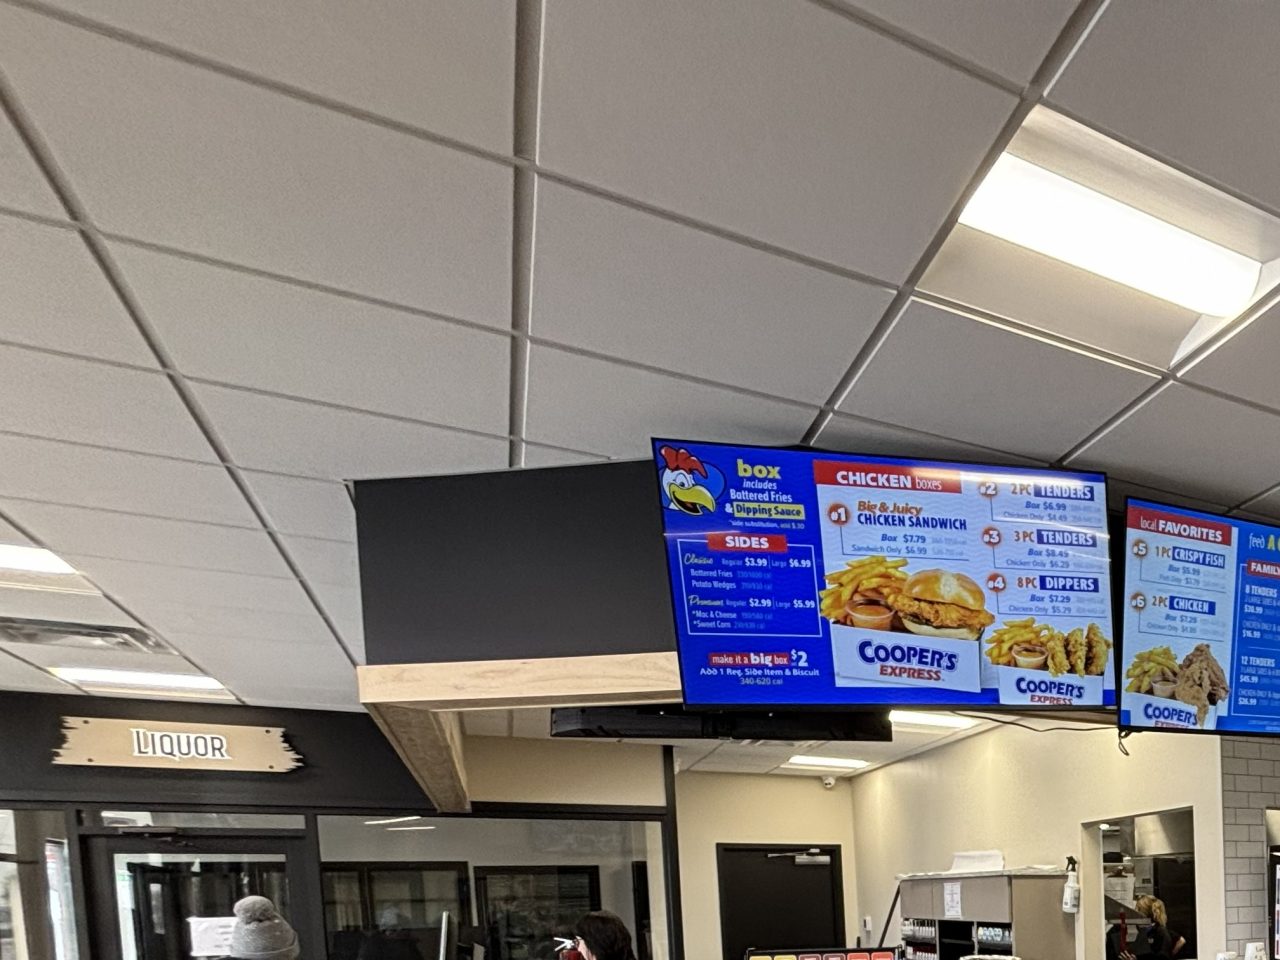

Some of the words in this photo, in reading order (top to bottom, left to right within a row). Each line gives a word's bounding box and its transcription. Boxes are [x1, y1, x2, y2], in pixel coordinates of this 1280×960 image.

[737, 458, 781, 480] box
[743, 479, 777, 489] includes
[836, 471, 912, 488] CHICKEN
[915, 476, 942, 491] boxes
[730, 488, 769, 501] Battered
[770, 491, 793, 502] Fries
[1019, 484, 1032, 496] PC
[1040, 485, 1091, 499] TENDERS
[736, 503, 773, 517] Dipping
[774, 505, 801, 516] Sauce
[857, 500, 877, 515] Big
[878, 502, 889, 513] &
[890, 502, 923, 517] Juicy
[857, 513, 906, 528] CHICKEN
[908, 516, 968, 531] SANDWICH
[1140, 516, 1157, 531] local
[1158, 519, 1223, 542] FAVORITES
[725, 535, 770, 549] SIDES
[881, 533, 898, 542] Box
[903, 533, 927, 544] $7.79
[1014, 531, 1020, 542] 3
[1022, 531, 1034, 543] PC
[1041, 531, 1093, 546] TENDERS
[1249, 532, 1266, 550] feed
[1267, 534, 1276, 551] A
[744, 557, 768, 567] $3.99
[789, 558, 812, 568] $6.99
[1174, 548, 1204, 564] CRISPY
[1206, 554, 1224, 568] FISH
[1025, 577, 1037, 588] PC
[1045, 577, 1095, 591] DIPPERS
[749, 598, 772, 608] $2.99
[1030, 594, 1045, 602] Box
[1173, 597, 1209, 613] CHICKEN
[712, 655, 733, 664] make
[735, 655, 742, 664] it
[750, 652, 773, 667] big
[774, 655, 788, 665] box
[858, 640, 957, 671] COOPER'S
[699, 668, 718, 676] Add
[744, 668, 763, 676] Side
[792, 668, 820, 676] Biscuit
[879, 664, 942, 682] EXPRESS
[1016, 677, 1085, 699] COOPER'S
[133, 729, 228, 759] LIQUOR
